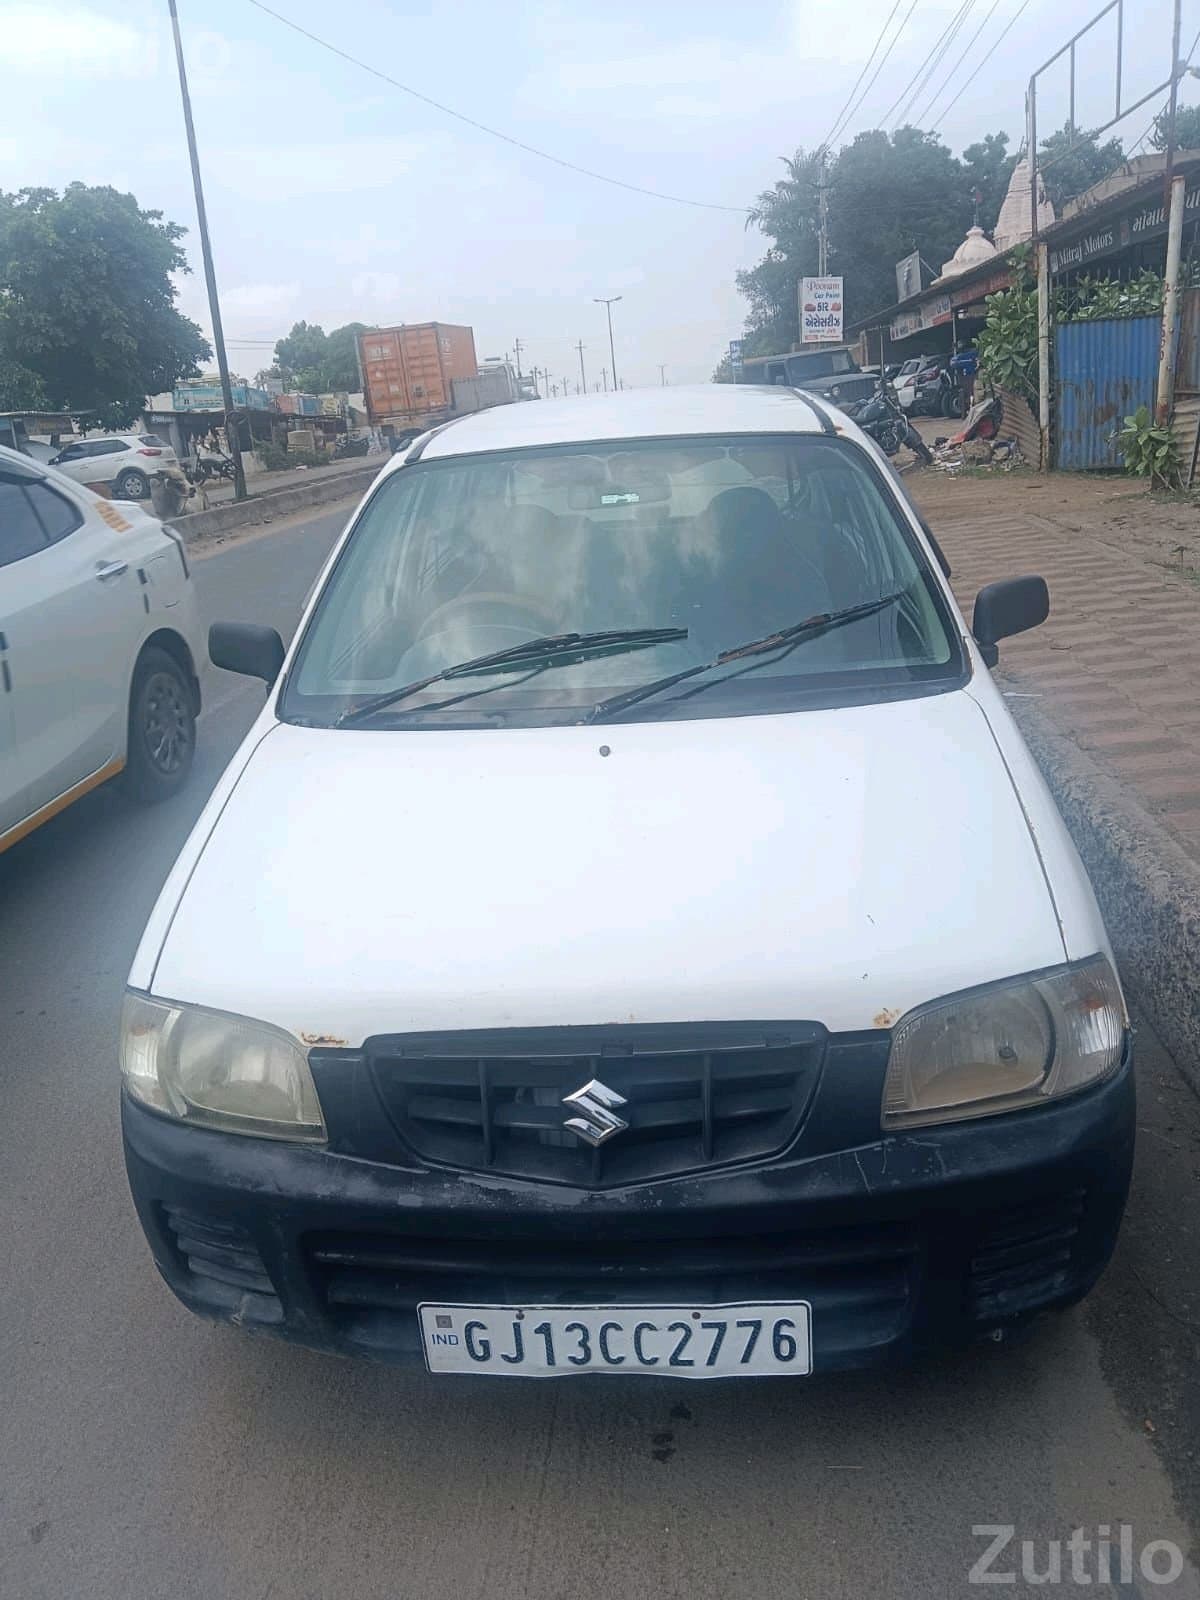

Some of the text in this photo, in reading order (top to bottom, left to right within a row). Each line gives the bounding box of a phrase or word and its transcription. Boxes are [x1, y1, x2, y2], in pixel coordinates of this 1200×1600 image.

[1084, 231, 1113, 256] Motors
[817, 302, 828, 312] કાર
[431, 1318, 797, 1368] IND GJ13CC2776
